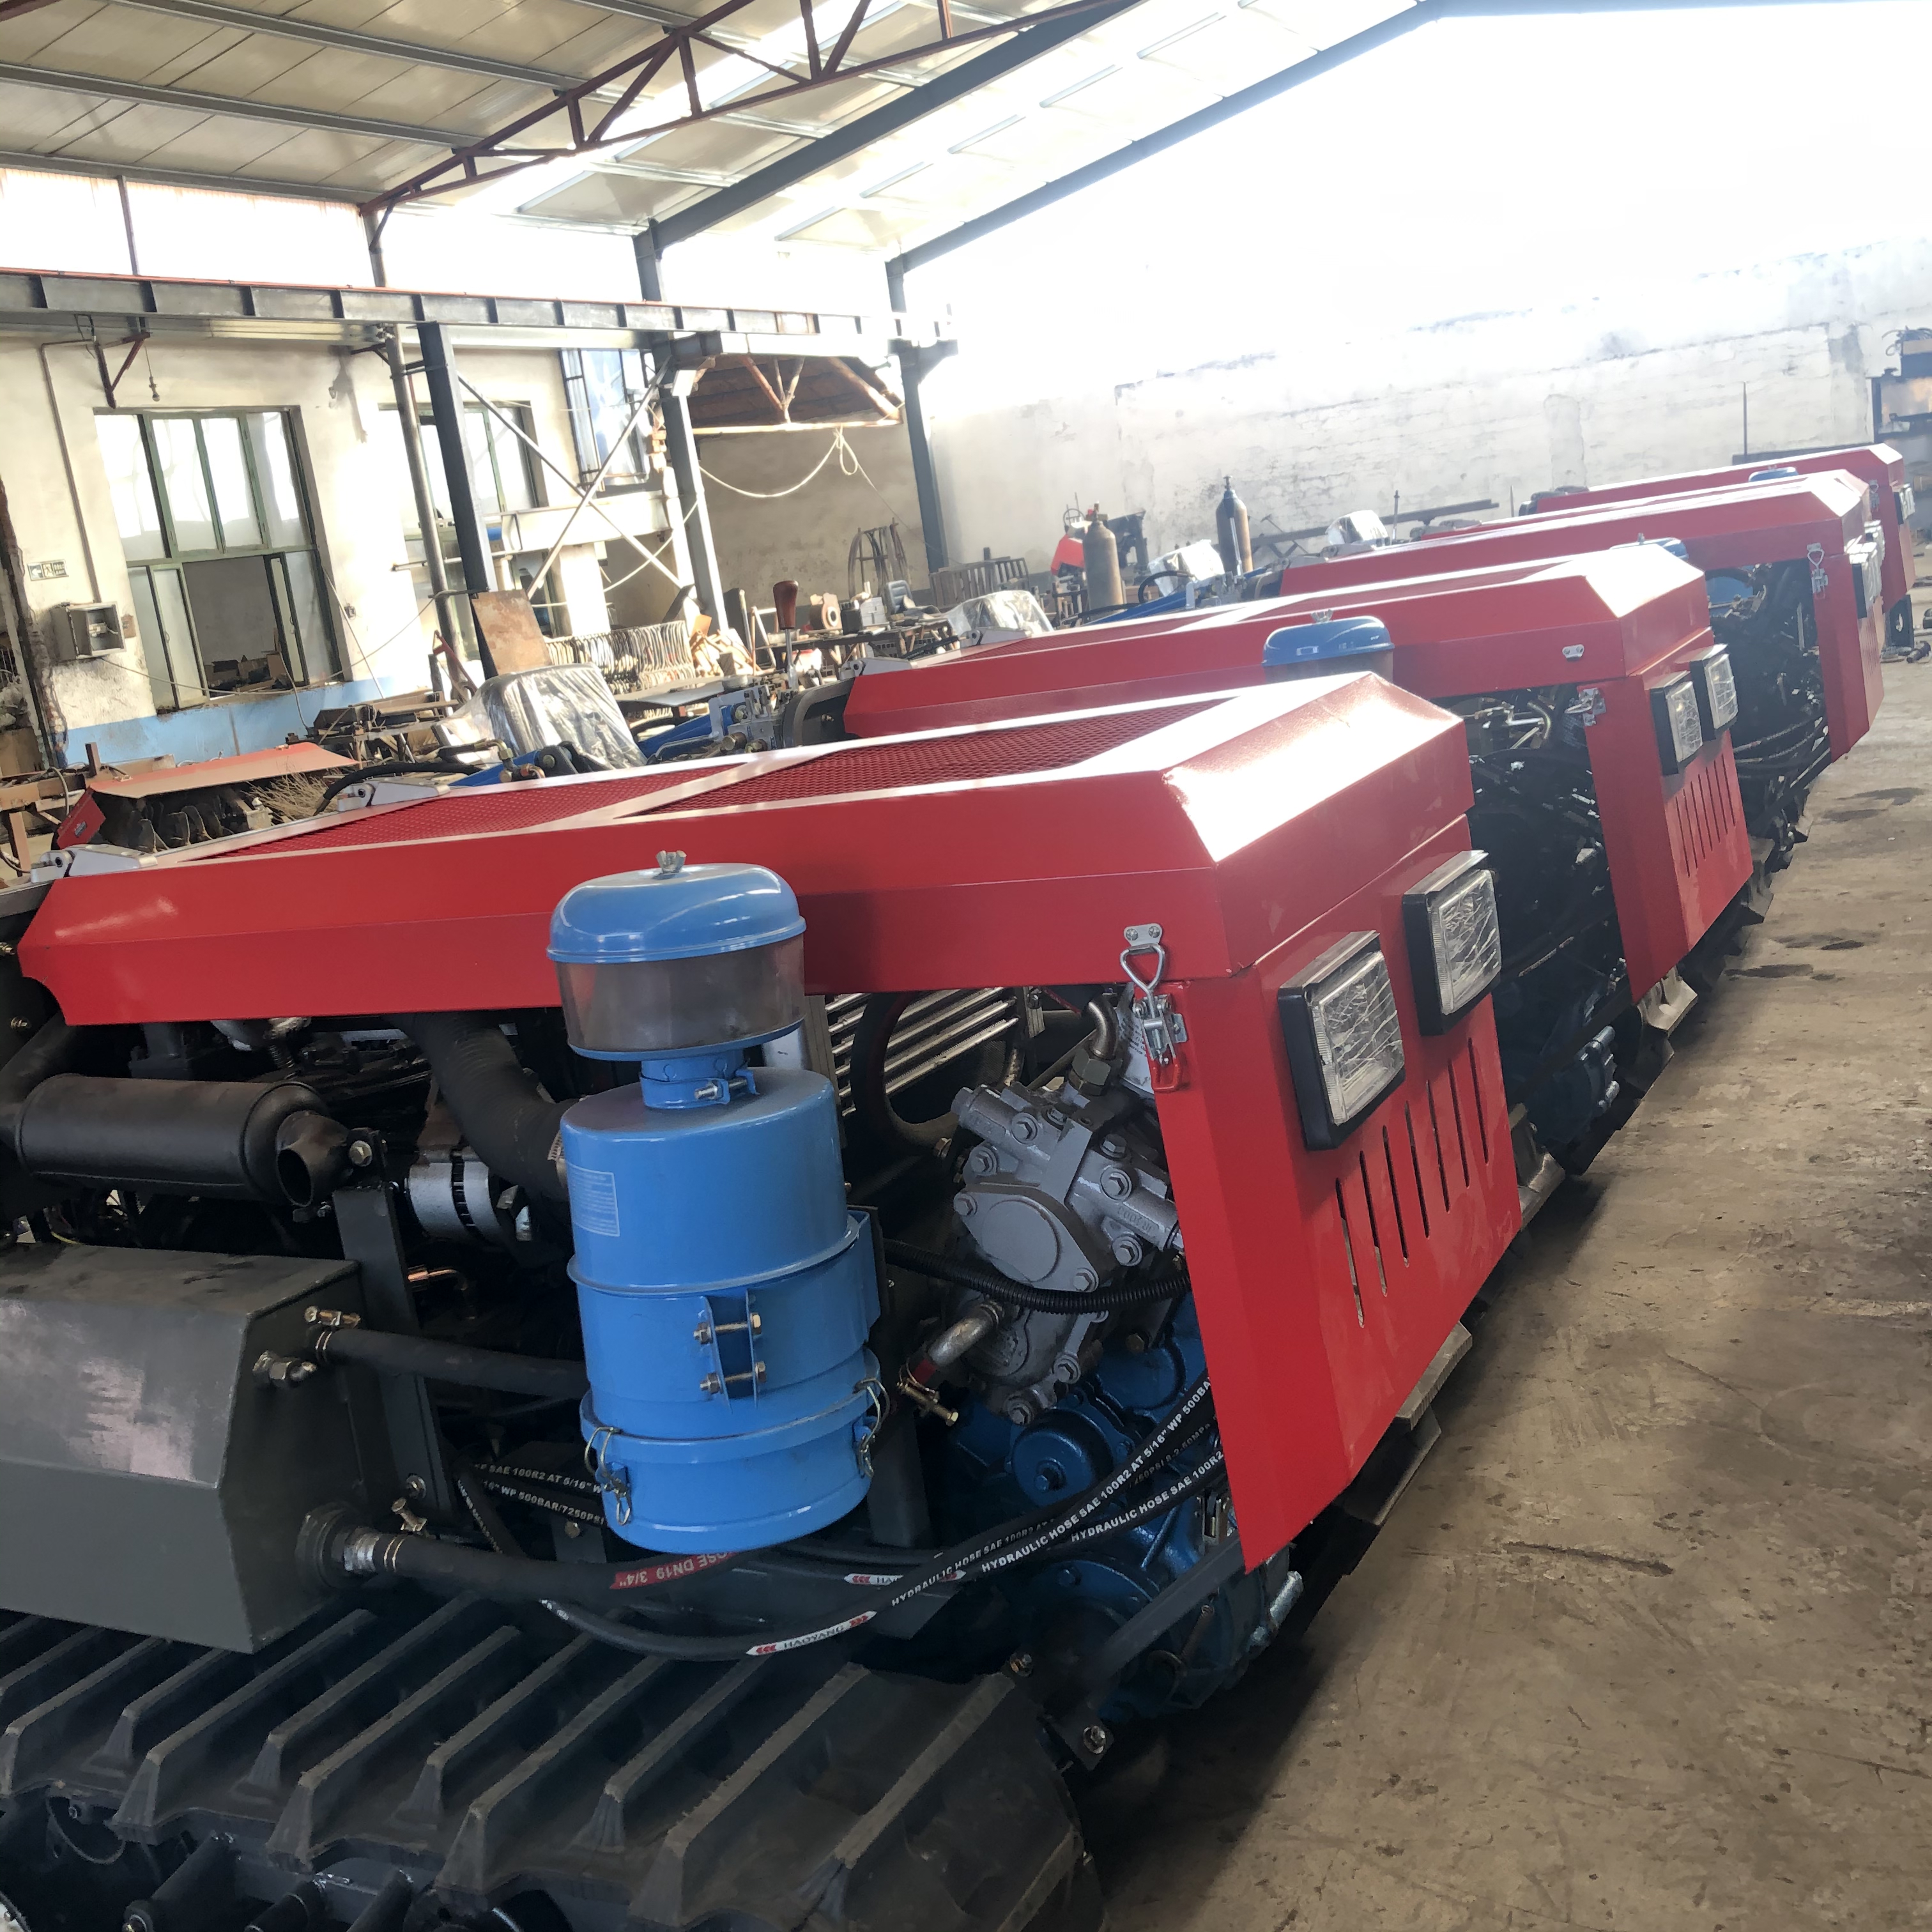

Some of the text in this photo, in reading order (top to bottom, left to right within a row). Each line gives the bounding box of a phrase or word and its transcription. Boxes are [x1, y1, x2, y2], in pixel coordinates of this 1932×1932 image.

[512, 1467, 546, 1480] 100R2
[547, 1474, 563, 1483] AT
[593, 1484, 602, 1494] W
[981, 1535, 1048, 1572] HYDRAULIC
[1049, 1514, 1080, 1540] HOSE
[1079, 1497, 1101, 1517] SAE
[1101, 1469, 1132, 1498] 100R2
[1131, 1455, 1144, 1472] AT
[1167, 1413, 1183, 1431] WP
[1182, 1376, 1211, 1414] 500BA
[502, 1485, 517, 1496] WP
[1071, 1450, 1224, 1542] HYDRAULIC HOSE SAE 100R2
[656, 1558, 694, 1579] DN19
[891, 1566, 953, 1606] HYDRAULIC
[954, 1549, 981, 1571] HOSE
[784, 1625, 845, 1649] HAOYANG
